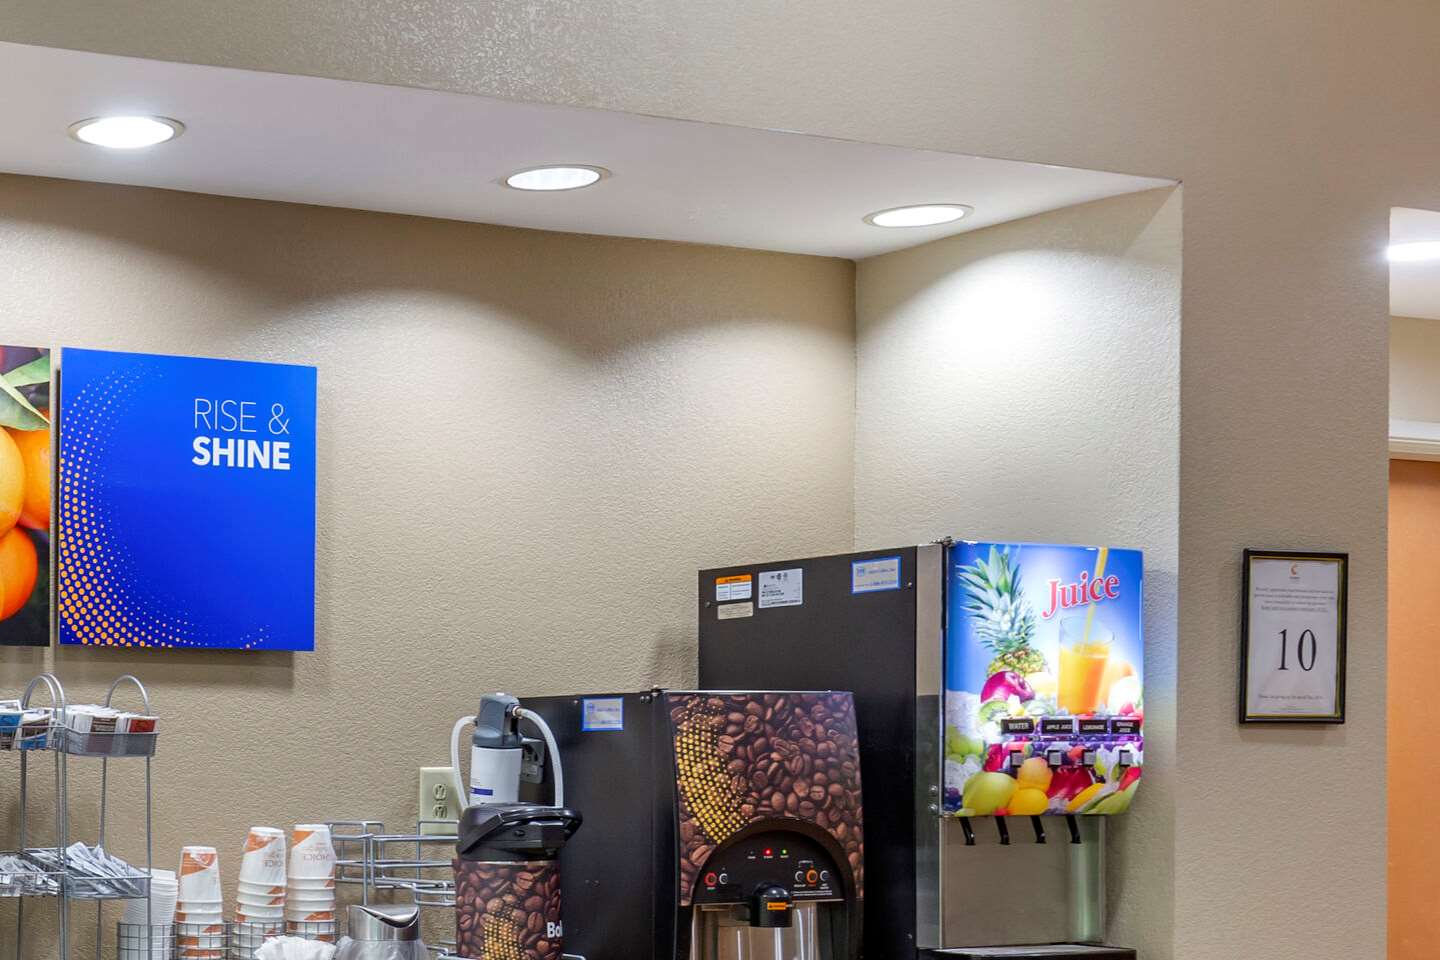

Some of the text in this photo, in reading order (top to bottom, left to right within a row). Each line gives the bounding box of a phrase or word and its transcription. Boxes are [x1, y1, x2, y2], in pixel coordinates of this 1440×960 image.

[194, 398, 290, 435] RISE &
[192, 436, 291, 470] SHINE
[1041, 570, 1121, 620] Juice
[1278, 629, 1317, 671] 10
[1008, 722, 1029, 730] WATER
